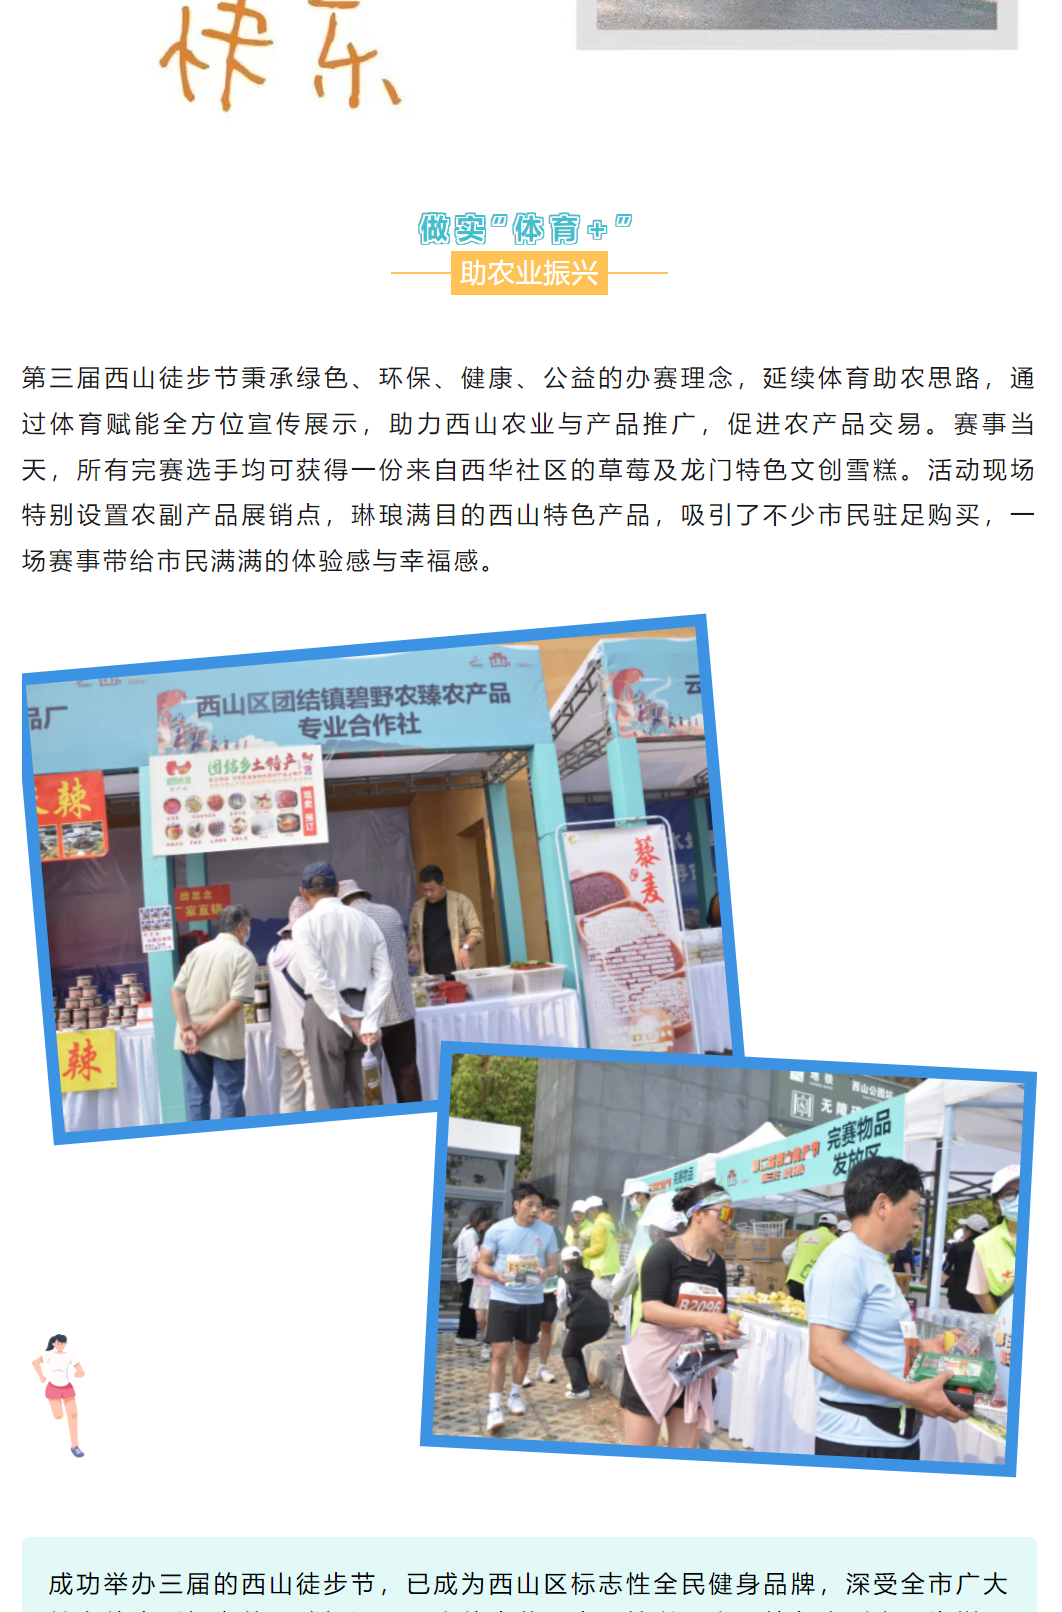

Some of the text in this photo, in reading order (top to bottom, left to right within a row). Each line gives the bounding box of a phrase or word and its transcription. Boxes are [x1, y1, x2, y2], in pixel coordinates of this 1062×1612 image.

[196, 680, 512, 719] 西山区团结镇碧野农臻农产品
[297, 711, 422, 740] 专业合作社
[207, 752, 297, 776] 团结乡土特产
[62, 1038, 102, 1082] 辣
[851, 1079, 894, 1100] 西山公园站
[827, 1108, 892, 1152] 完赛物品
[678, 1298, 722, 1314] B2096
